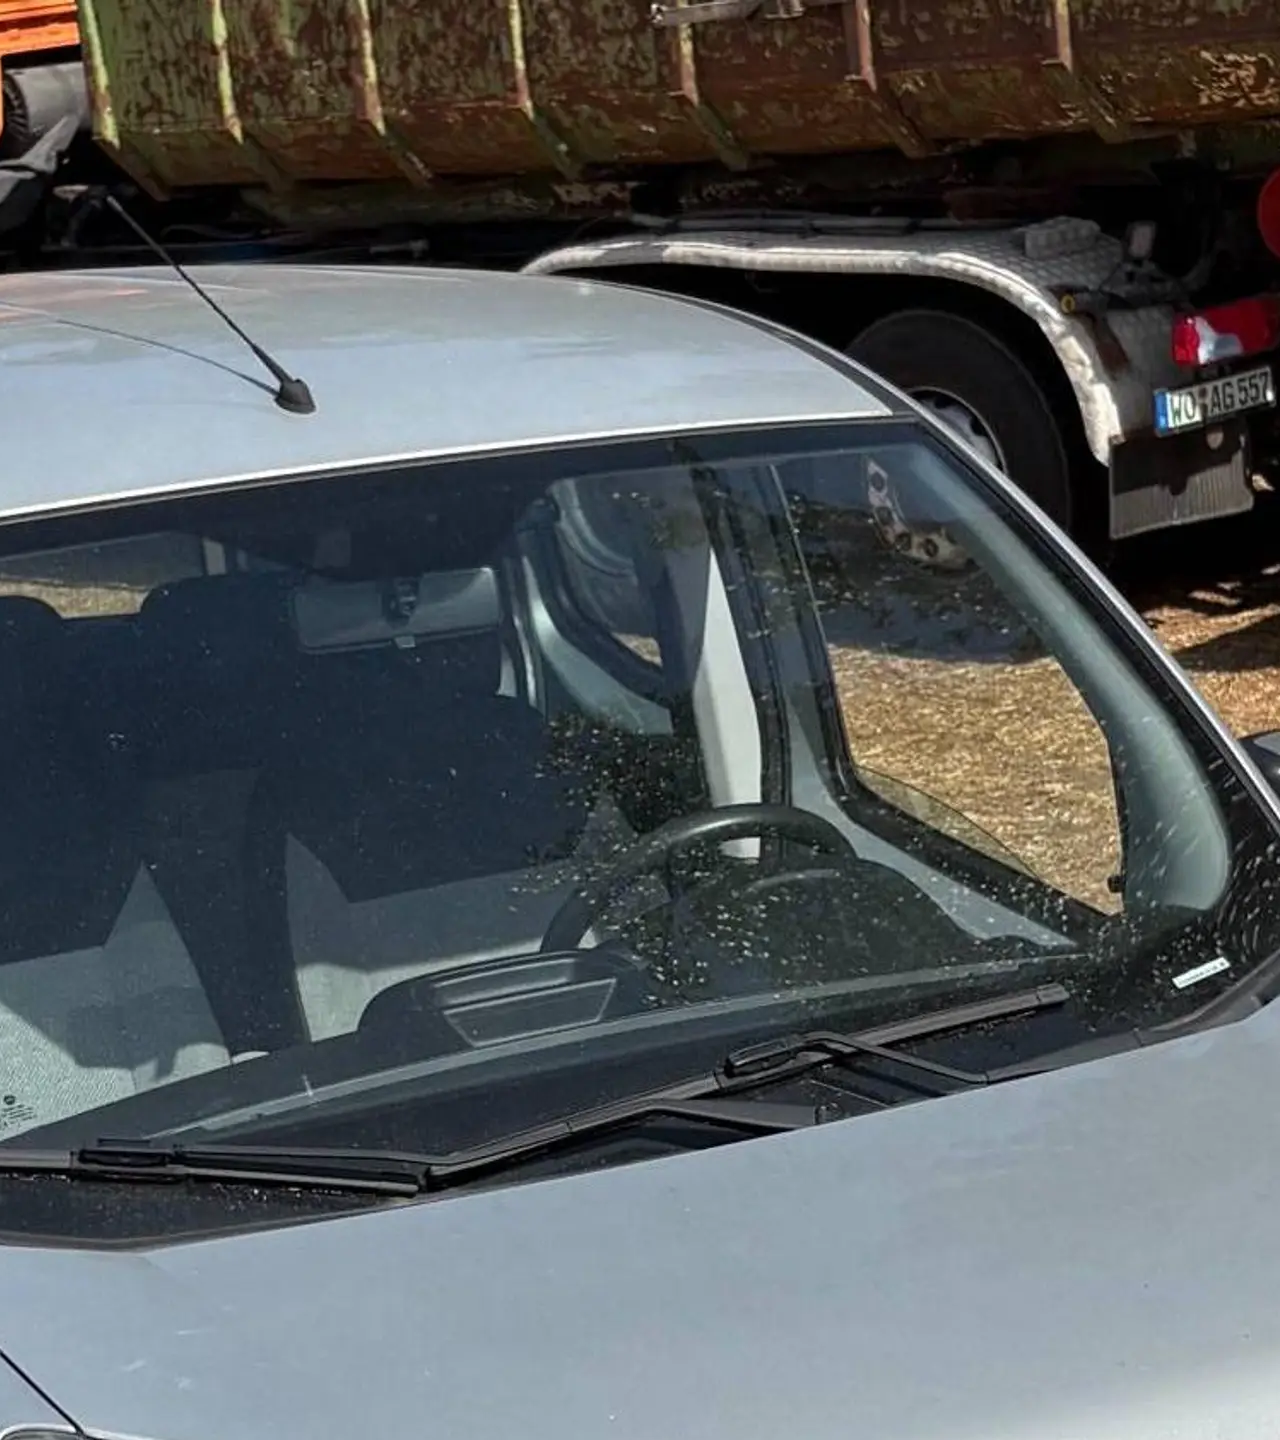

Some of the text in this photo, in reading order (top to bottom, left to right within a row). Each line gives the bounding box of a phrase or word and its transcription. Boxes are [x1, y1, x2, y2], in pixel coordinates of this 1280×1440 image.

[1170, 371, 1269, 426] WO AG 557
